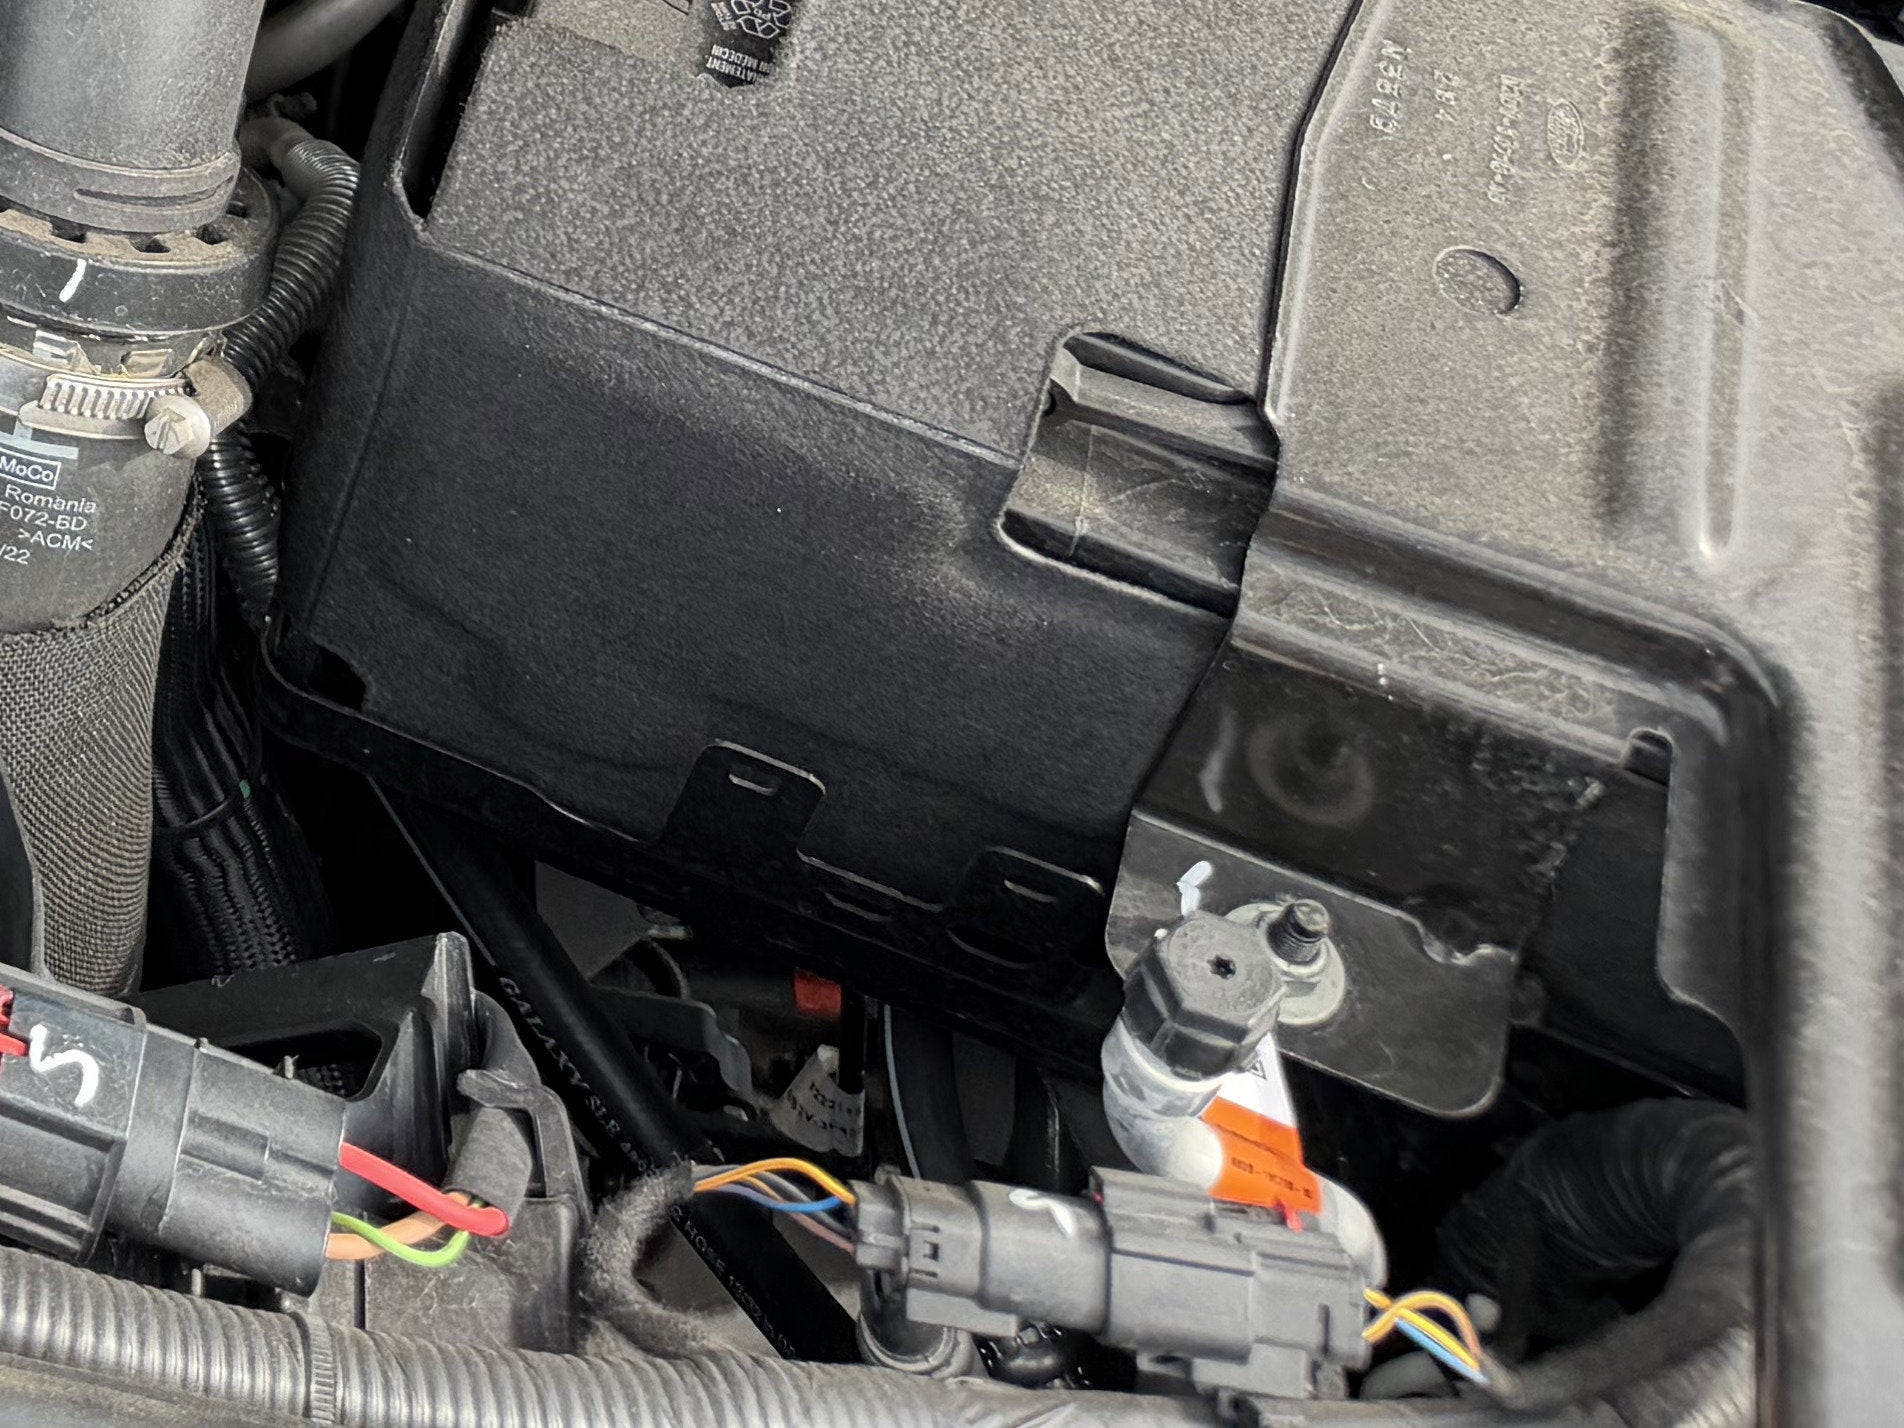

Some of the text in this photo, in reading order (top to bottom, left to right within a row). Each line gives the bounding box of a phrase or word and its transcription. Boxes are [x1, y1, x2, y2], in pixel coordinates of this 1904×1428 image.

[5, 483, 97, 514] Romania
[18, 528, 94, 551] >ACM<
[499, 977, 590, 1089] GALAXY
